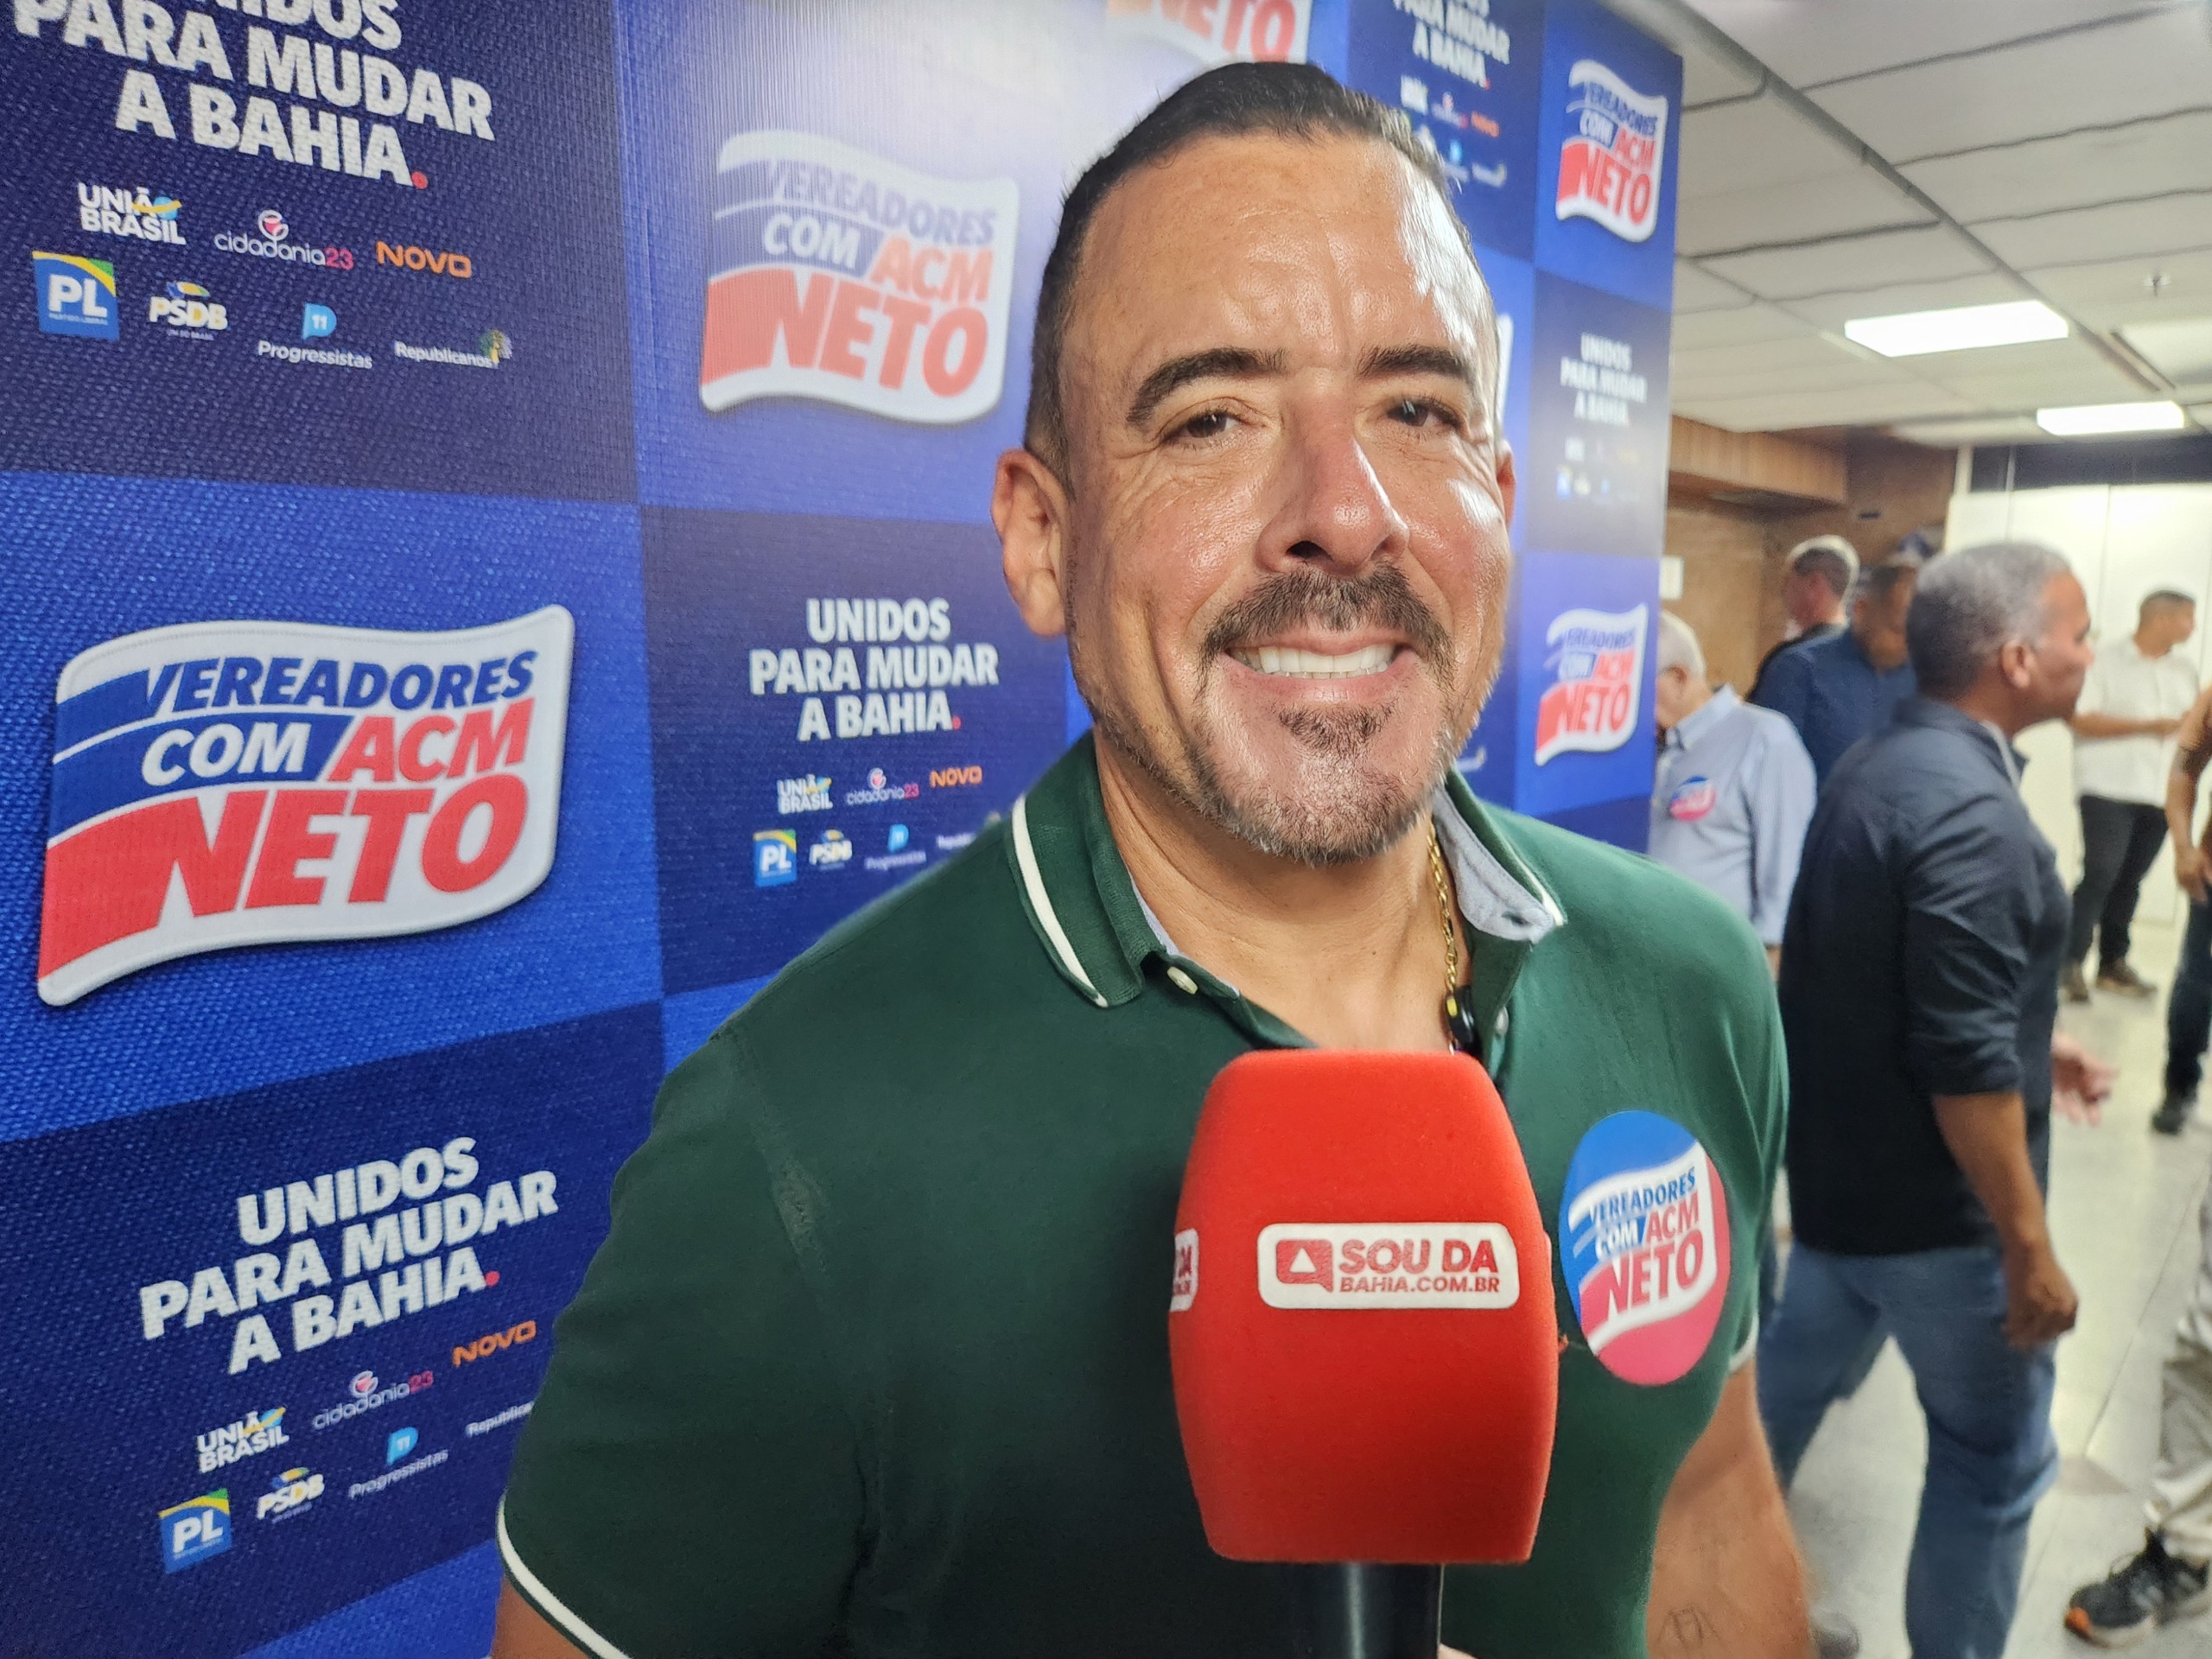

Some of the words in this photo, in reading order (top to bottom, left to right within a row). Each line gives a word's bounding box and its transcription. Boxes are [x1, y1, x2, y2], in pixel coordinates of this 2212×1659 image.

[14, 0, 235, 81] PARA
[248, 26, 496, 141] MUDAR
[116, 69, 175, 139] A
[190, 84, 429, 189] BAHIA.
[765, 159, 999, 246] VEREADORES
[1571, 143, 1651, 226] NETO
[80, 207, 186, 245] BRASIL
[376, 240, 473, 278] NOVO
[764, 213, 861, 269] COM
[870, 233, 995, 302] ACM
[48, 273, 107, 318] PL
[149, 296, 228, 330] PSDB
[258, 340, 373, 370] Progressistas
[394, 340, 494, 369] Republicanos
[734, 268, 988, 398] NETO
[805, 597, 951, 643] UNIDOS
[136, 650, 538, 716] VEREADORES
[749, 646, 861, 695] PARA
[868, 643, 1000, 690] MUDAR
[797, 697, 831, 741] A
[835, 690, 962, 739] BAHIA.
[1548, 683, 1630, 735] NETO
[143, 722, 305, 786] COM
[327, 697, 535, 783] ACM
[929, 765, 983, 788] NOVO
[778, 792, 833, 814] BRASIL
[97, 774, 529, 938] NETO
[761, 843, 792, 872] PL
[236, 1137, 479, 1246] UNIDOS
[1588, 1166, 1696, 1224] VEREADORES
[1595, 1218, 1639, 1260] COM
[1644, 1192, 1700, 1244] ACM
[139, 1238, 332, 1340] PARA
[342, 1170, 559, 1277] MUDAR
[1338, 1239, 1431, 1274] SOU
[1441, 1239, 1499, 1274] DA
[1592, 1229, 1705, 1320] NETO
[1338, 1275, 1500, 1294] BAHIA.COM.BR
[229, 1313, 282, 1376] A
[292, 1246, 500, 1352] BAHIA.
[451, 1319, 537, 1368] NOVO
[199, 1426, 290, 1474] BRASIL
[257, 1473, 325, 1521] PSDB
[173, 1509, 224, 1554] PL
